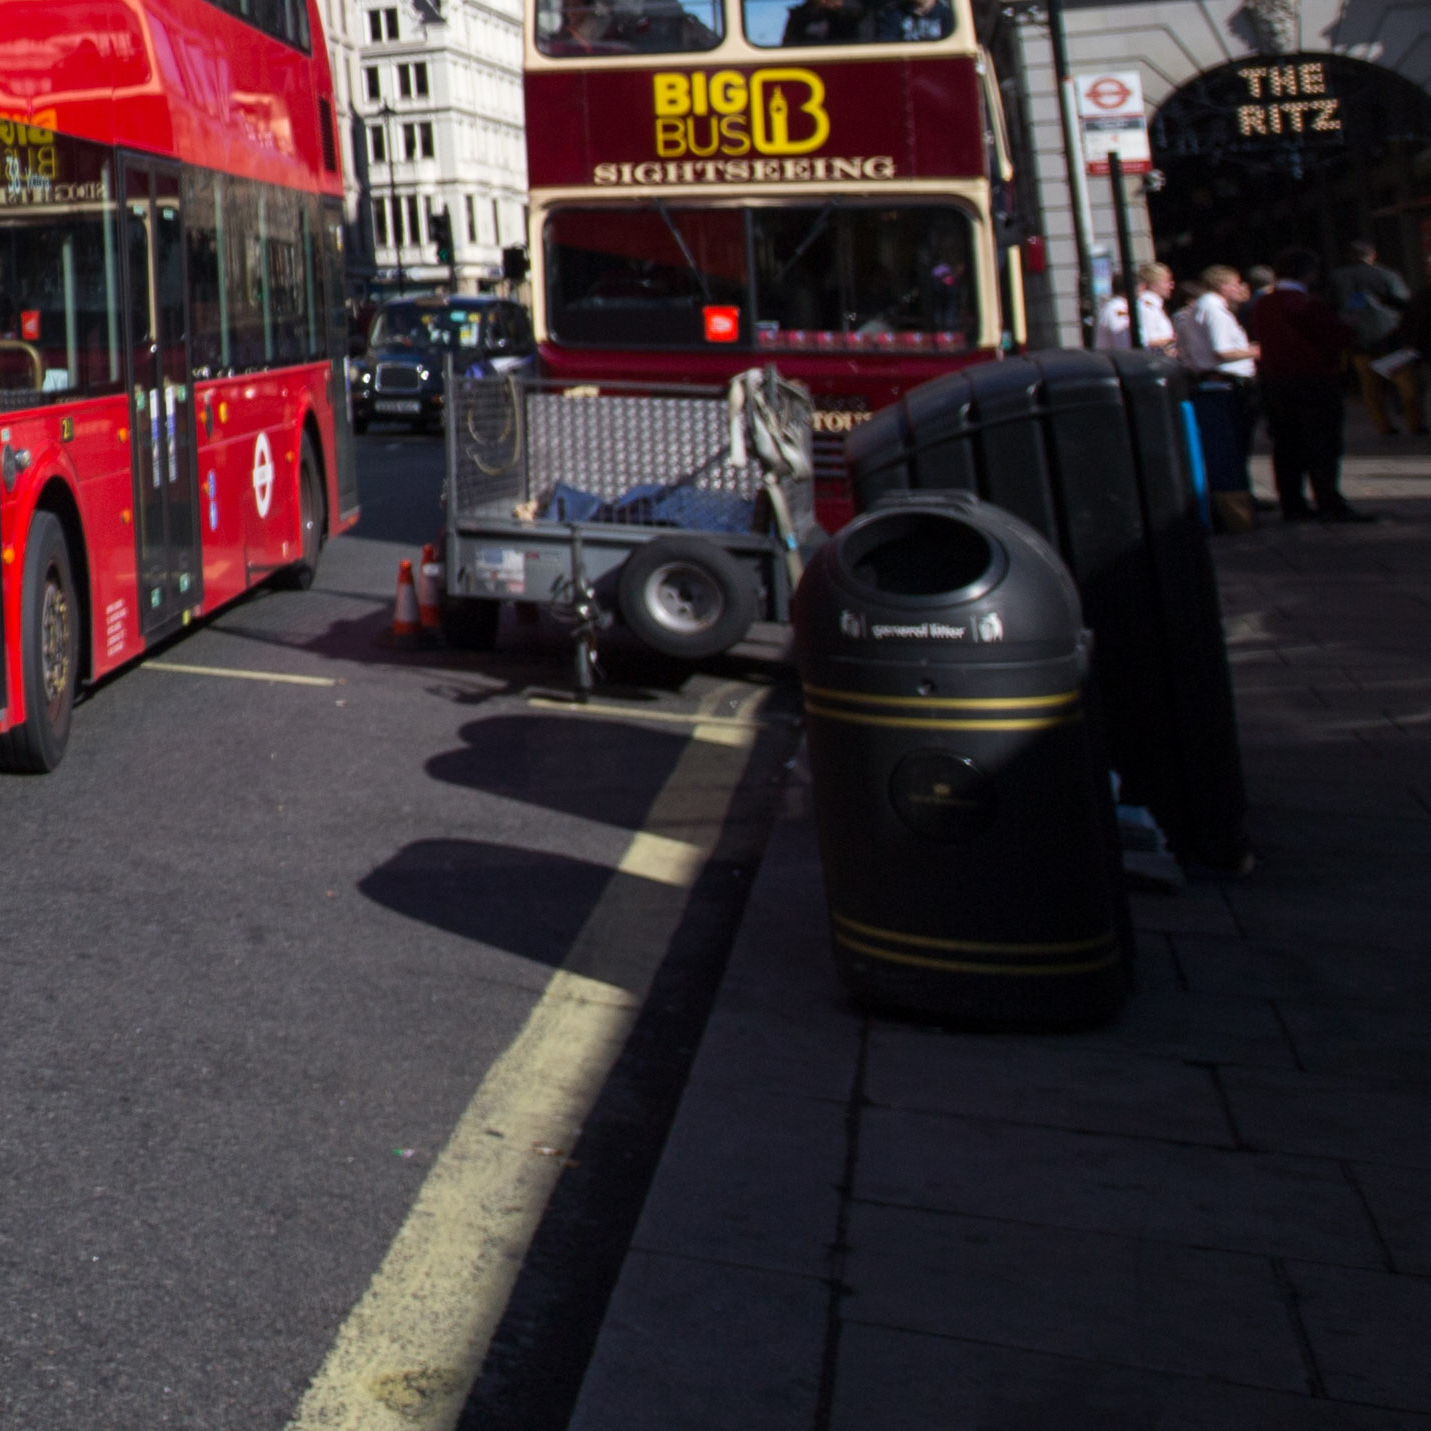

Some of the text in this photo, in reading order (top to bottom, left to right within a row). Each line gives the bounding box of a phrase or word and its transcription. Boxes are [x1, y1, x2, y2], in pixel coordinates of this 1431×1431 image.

[653, 70, 749, 116] BIG
[1238, 62, 1326, 98] THE
[655, 114, 752, 158] BUS
[1238, 98, 1342, 136] RITZ
[593, 154, 895, 185] SIGHTSEEING
